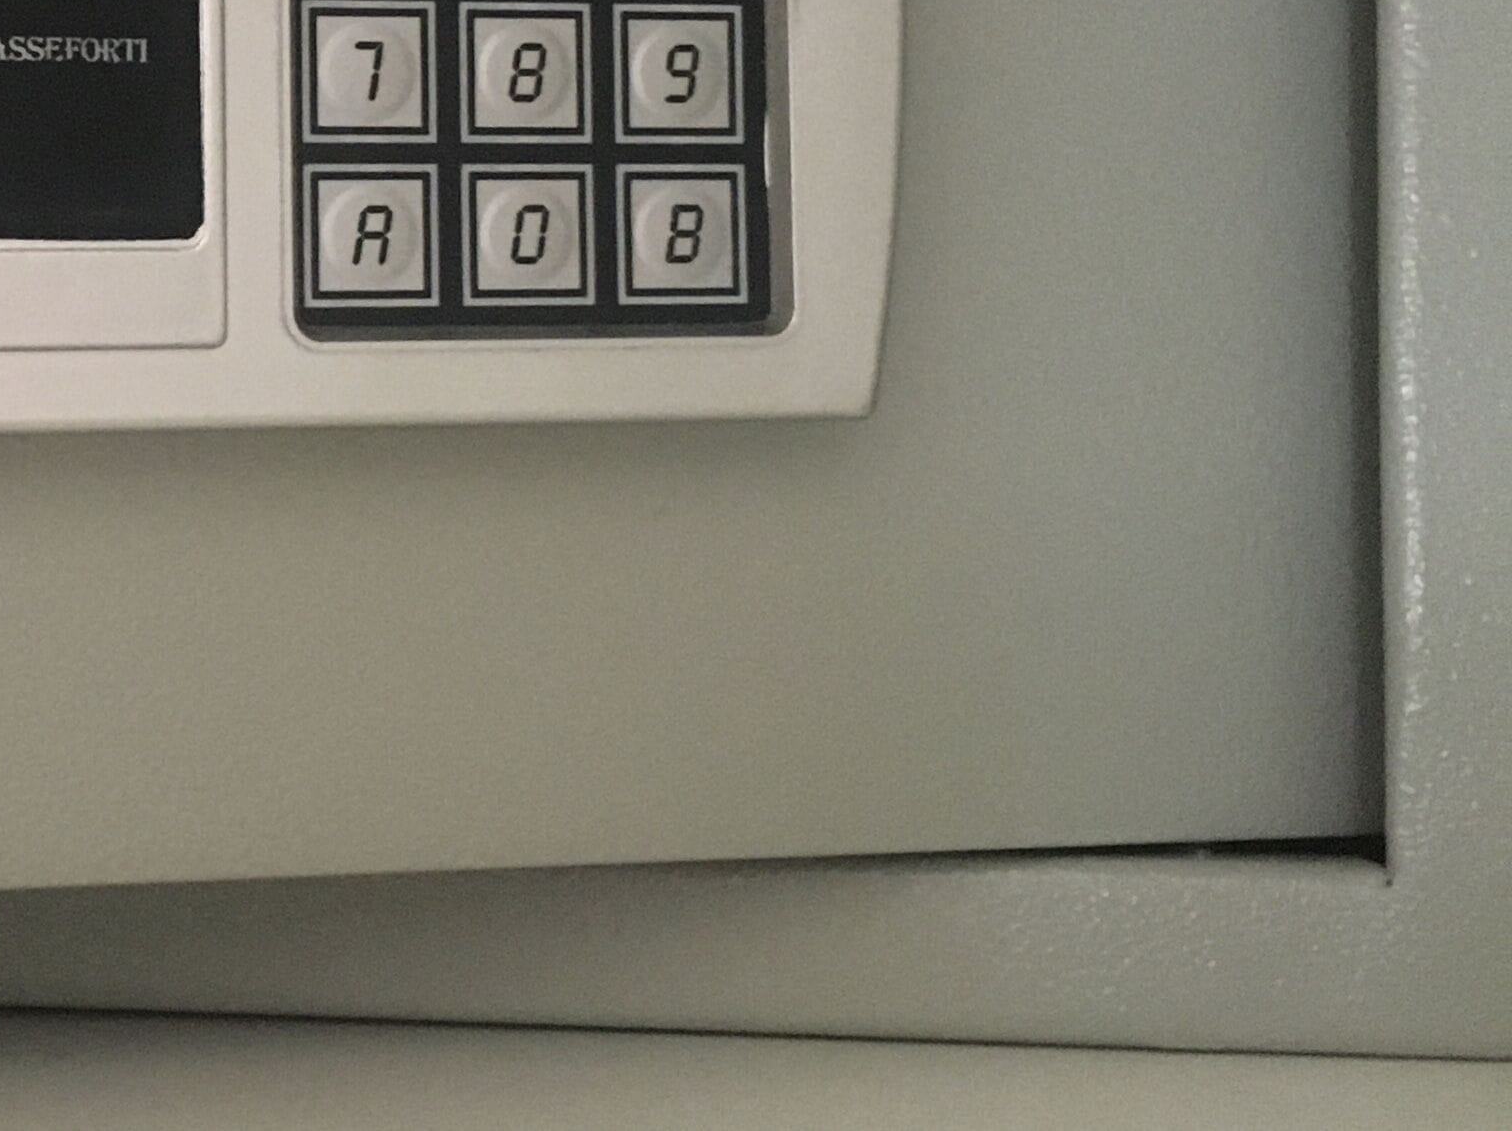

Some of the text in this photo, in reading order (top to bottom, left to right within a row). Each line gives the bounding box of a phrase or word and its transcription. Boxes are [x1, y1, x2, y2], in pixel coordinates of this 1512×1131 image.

[354, 40, 384, 102] 7
[508, 42, 548, 104] 8
[664, 43, 700, 104] 9
[351, 204, 394, 266] A
[510, 204, 551, 266] 0
